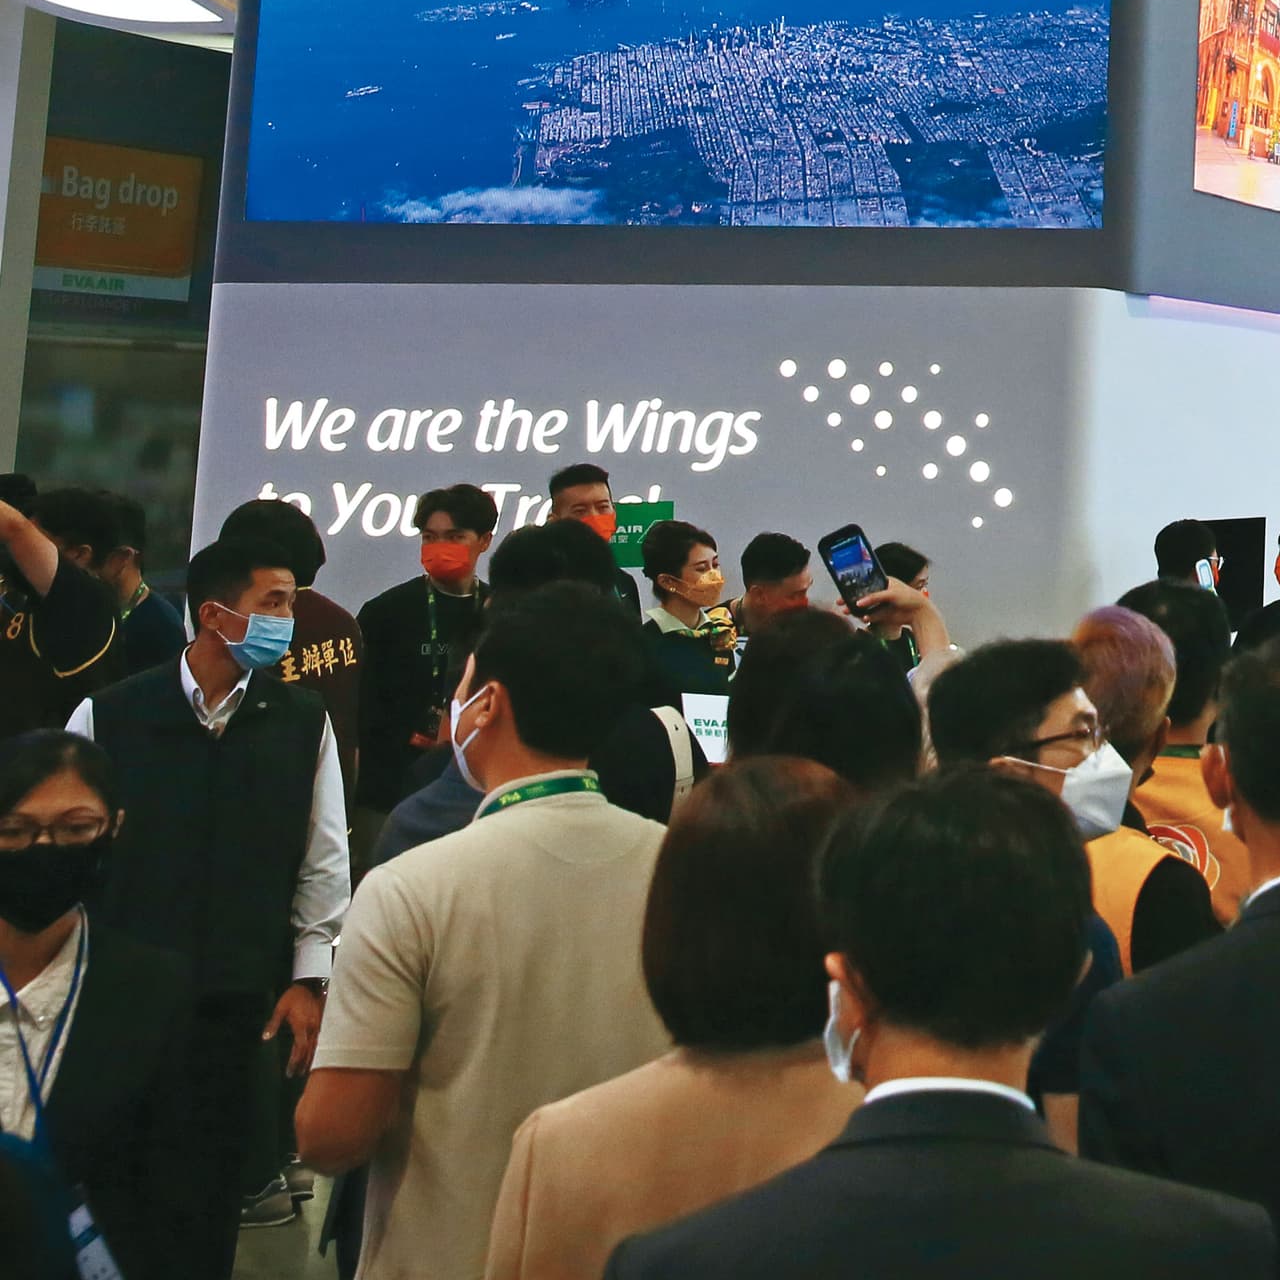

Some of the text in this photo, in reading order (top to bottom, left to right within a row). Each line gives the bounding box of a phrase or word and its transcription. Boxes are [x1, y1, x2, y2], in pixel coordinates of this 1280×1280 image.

[61, 165, 178, 216] Bag drop
[264, 397, 762, 472] We are the Wings
